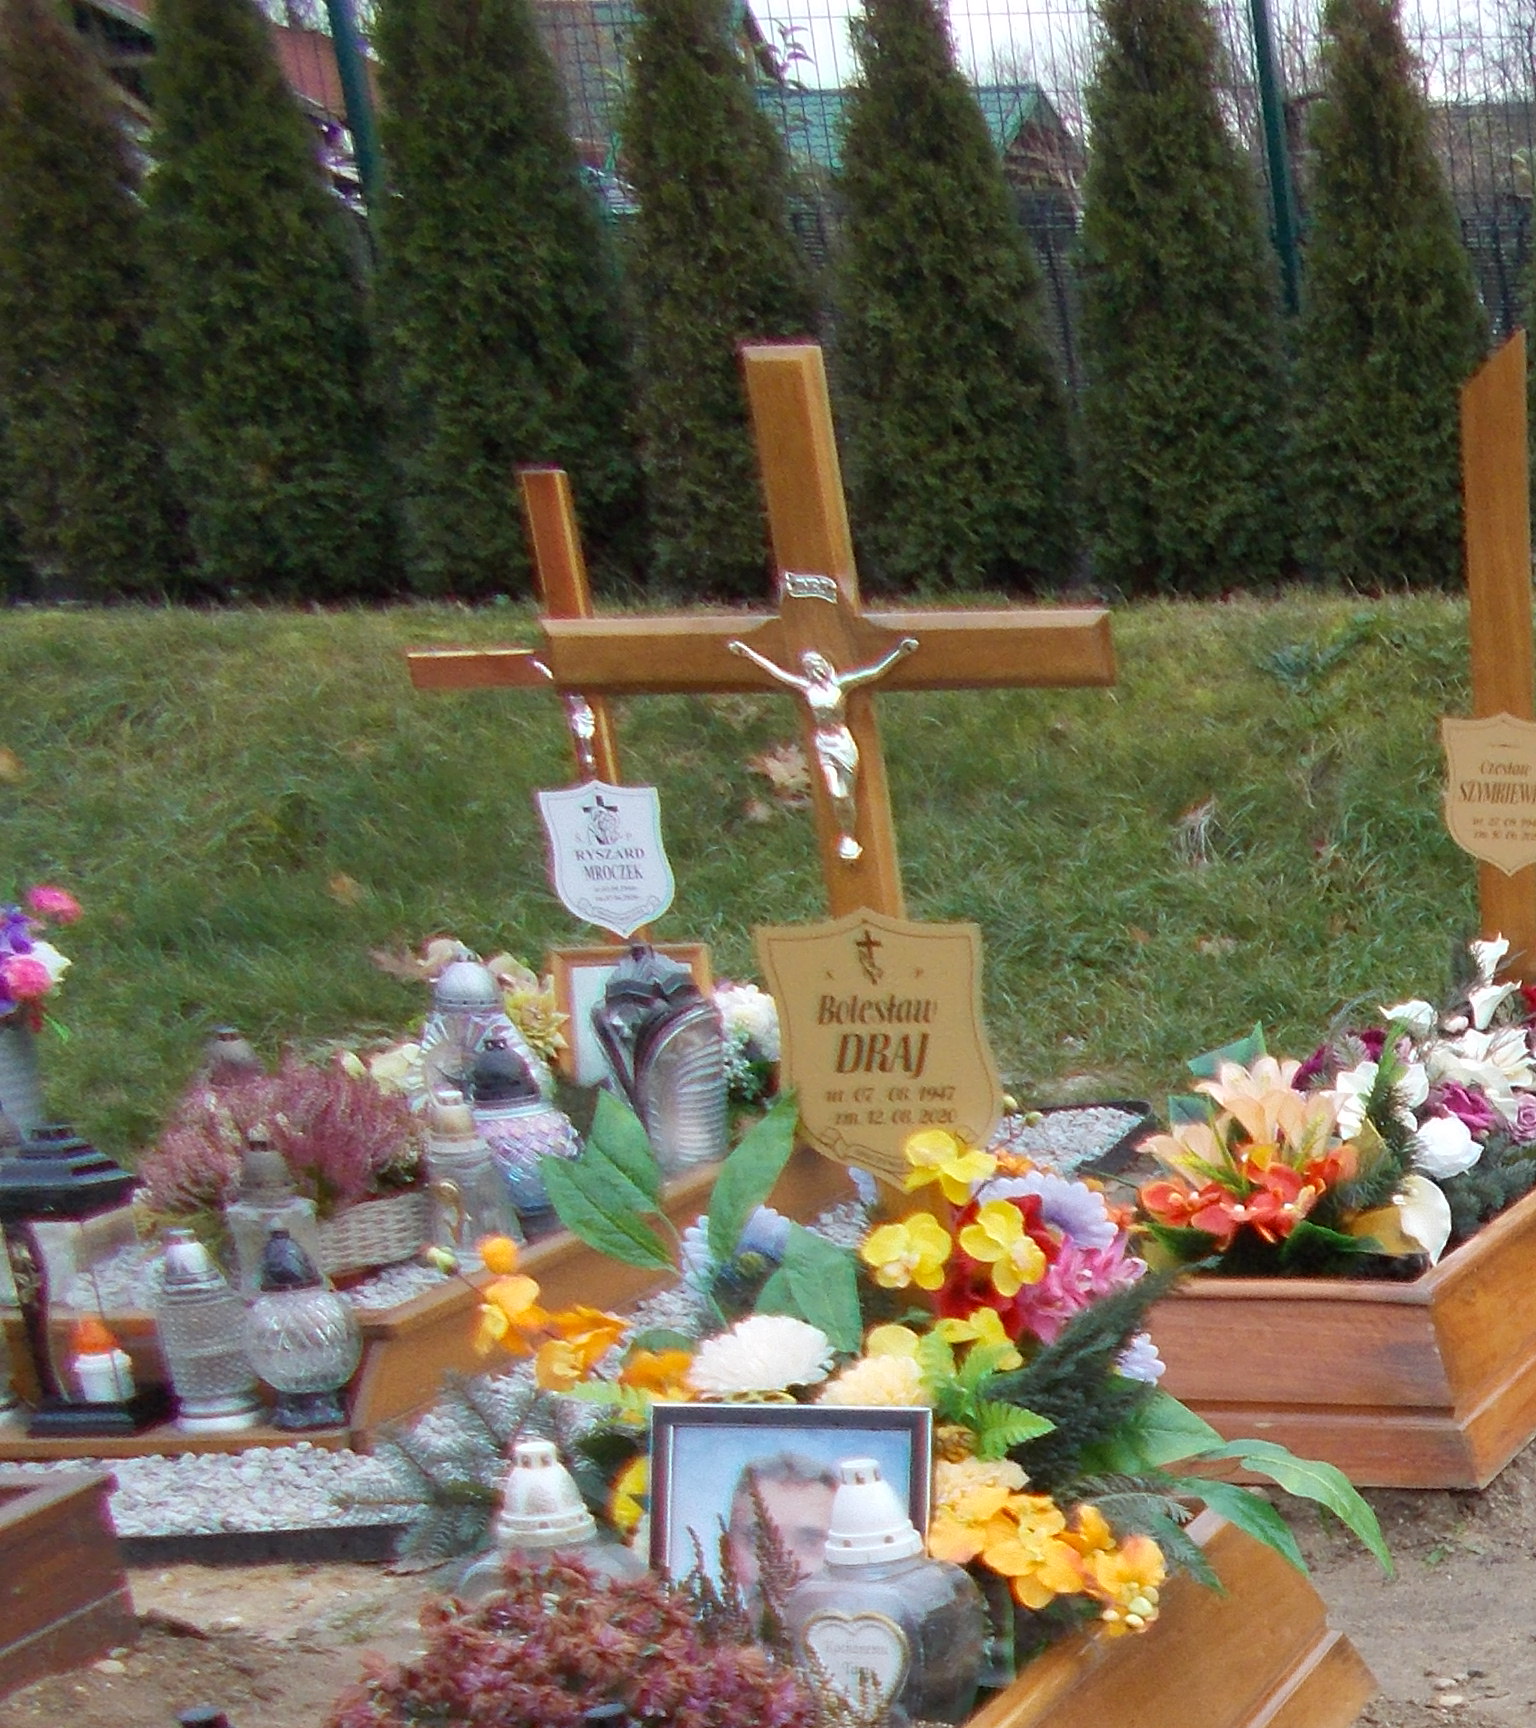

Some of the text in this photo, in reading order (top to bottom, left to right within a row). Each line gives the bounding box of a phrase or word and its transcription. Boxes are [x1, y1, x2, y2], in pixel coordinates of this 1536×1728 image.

[575, 848, 645, 861] RYSZARD
[584, 864, 643, 881] MROCZEK
[836, 1032, 931, 1079] DRAJ
